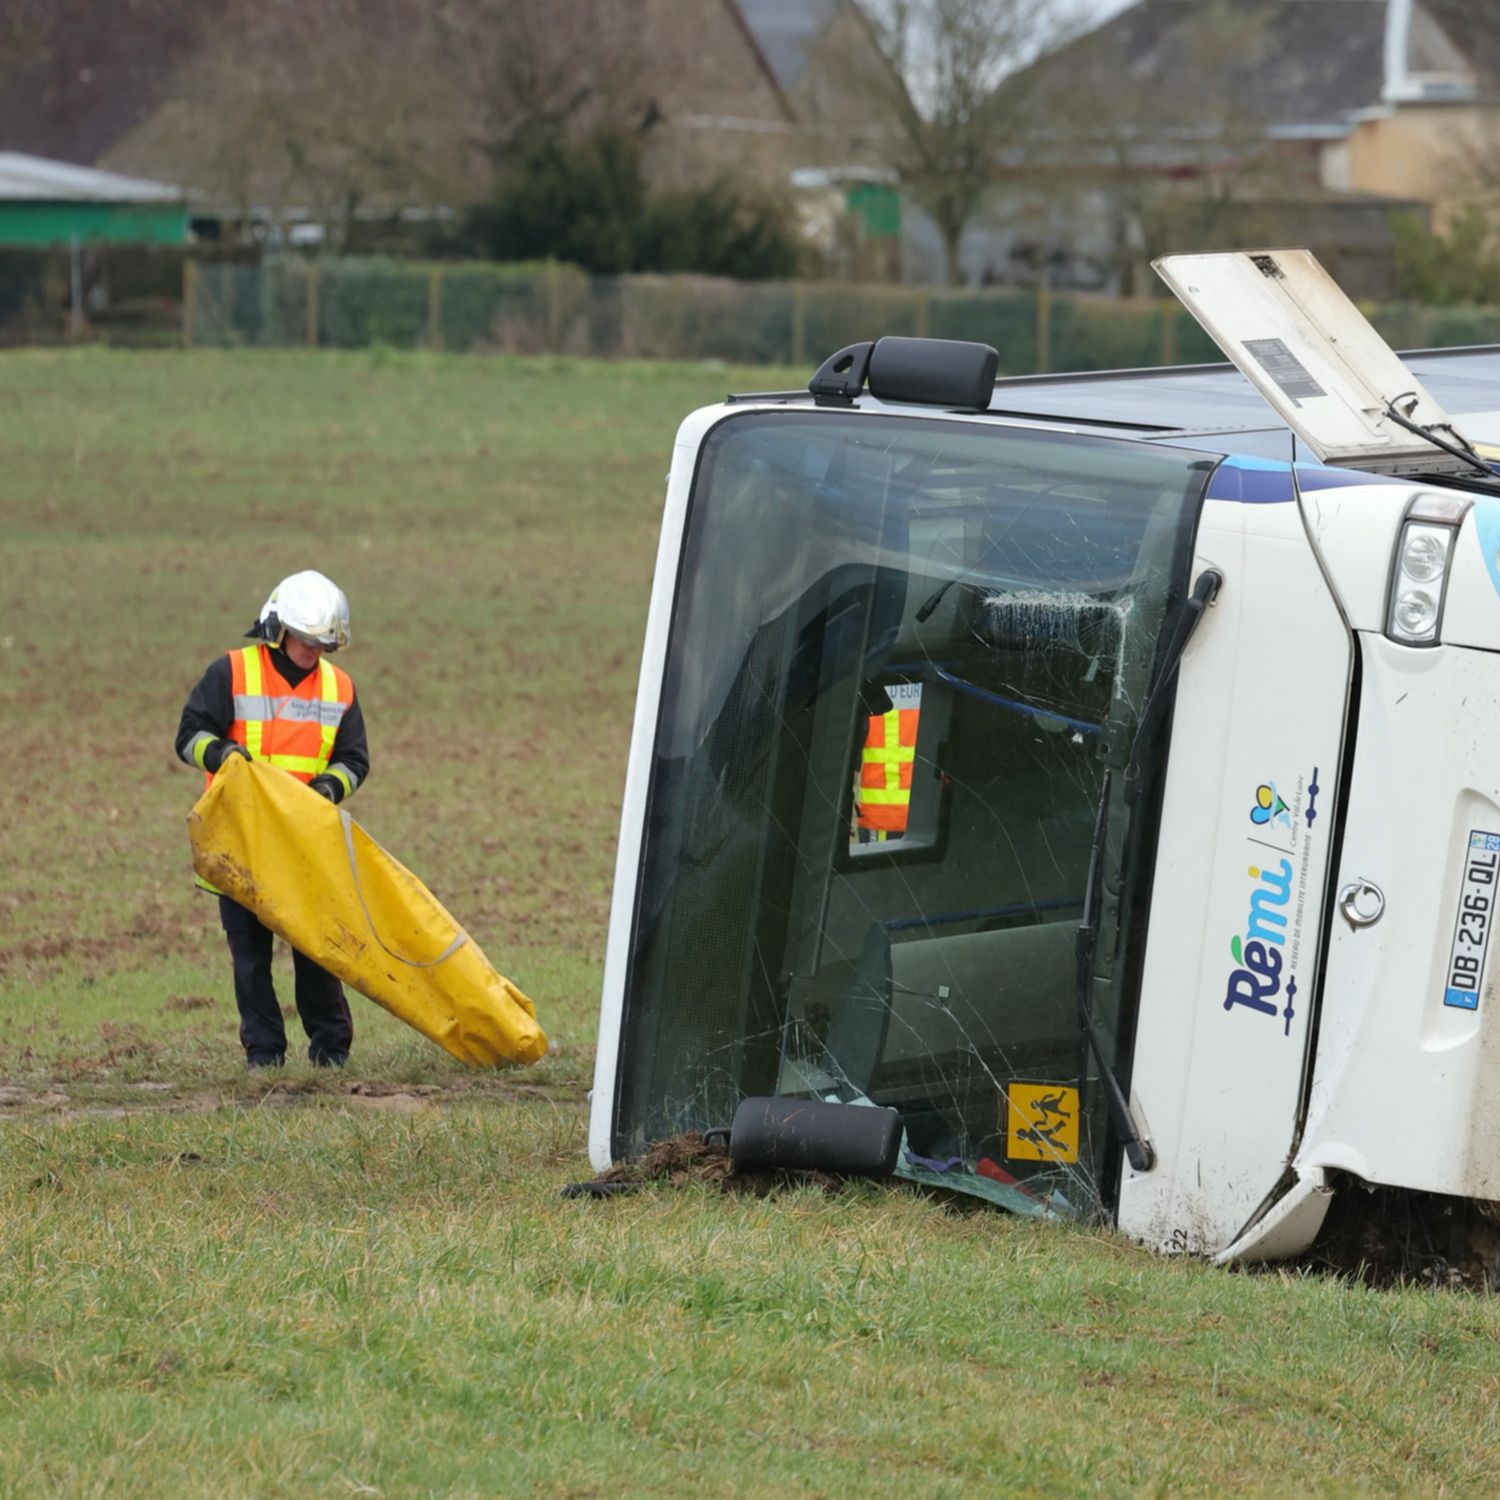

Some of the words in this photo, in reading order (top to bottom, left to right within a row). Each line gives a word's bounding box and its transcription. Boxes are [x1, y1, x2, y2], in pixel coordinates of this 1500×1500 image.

[1289, 820, 1299, 848] Centre
[1487, 835, 1500, 850] 28
[1294, 928, 1301, 938] DE
[1451, 853, 1497, 990] DB-236-QL
[1223, 858, 1293, 1017] Rémi
